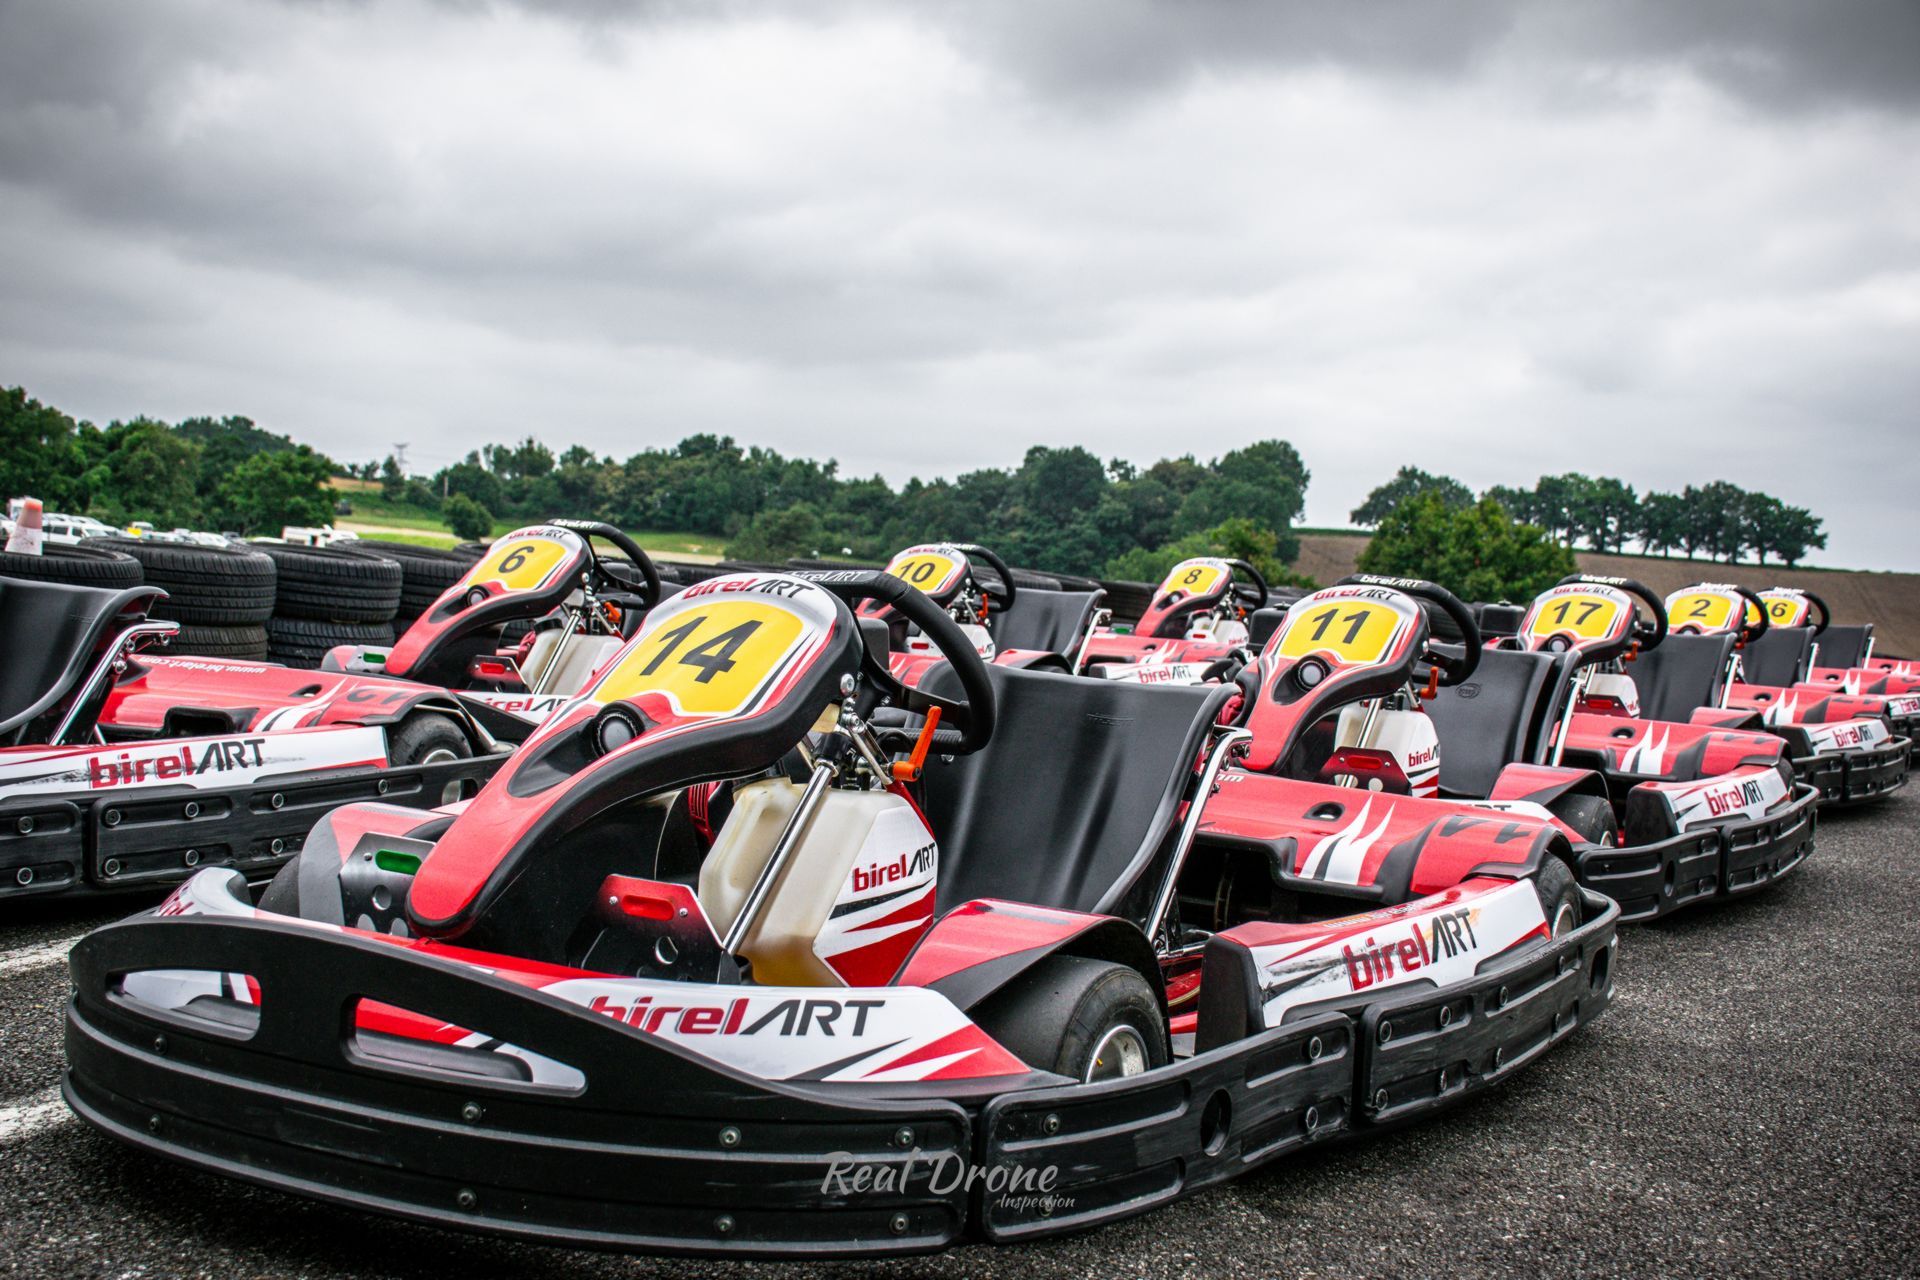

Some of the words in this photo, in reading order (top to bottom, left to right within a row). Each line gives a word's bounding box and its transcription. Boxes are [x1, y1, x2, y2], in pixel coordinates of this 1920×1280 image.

[498, 545, 535, 574] 6
[900, 561, 936, 584] 10
[1183, 568, 1203, 585] 8
[1360, 574, 1423, 588] birelART
[1553, 600, 1603, 626] 17
[1688, 598, 1712, 618] 2
[1764, 601, 1788, 618] 6
[1310, 608, 1371, 645] 11
[640, 615, 763, 684] 14
[1138, 665, 1193, 684] birelART
[89, 738, 266, 790] birelART
[1704, 779, 1764, 817] birelART
[852, 842, 936, 893] birelART
[1341, 907, 1478, 992] birelART
